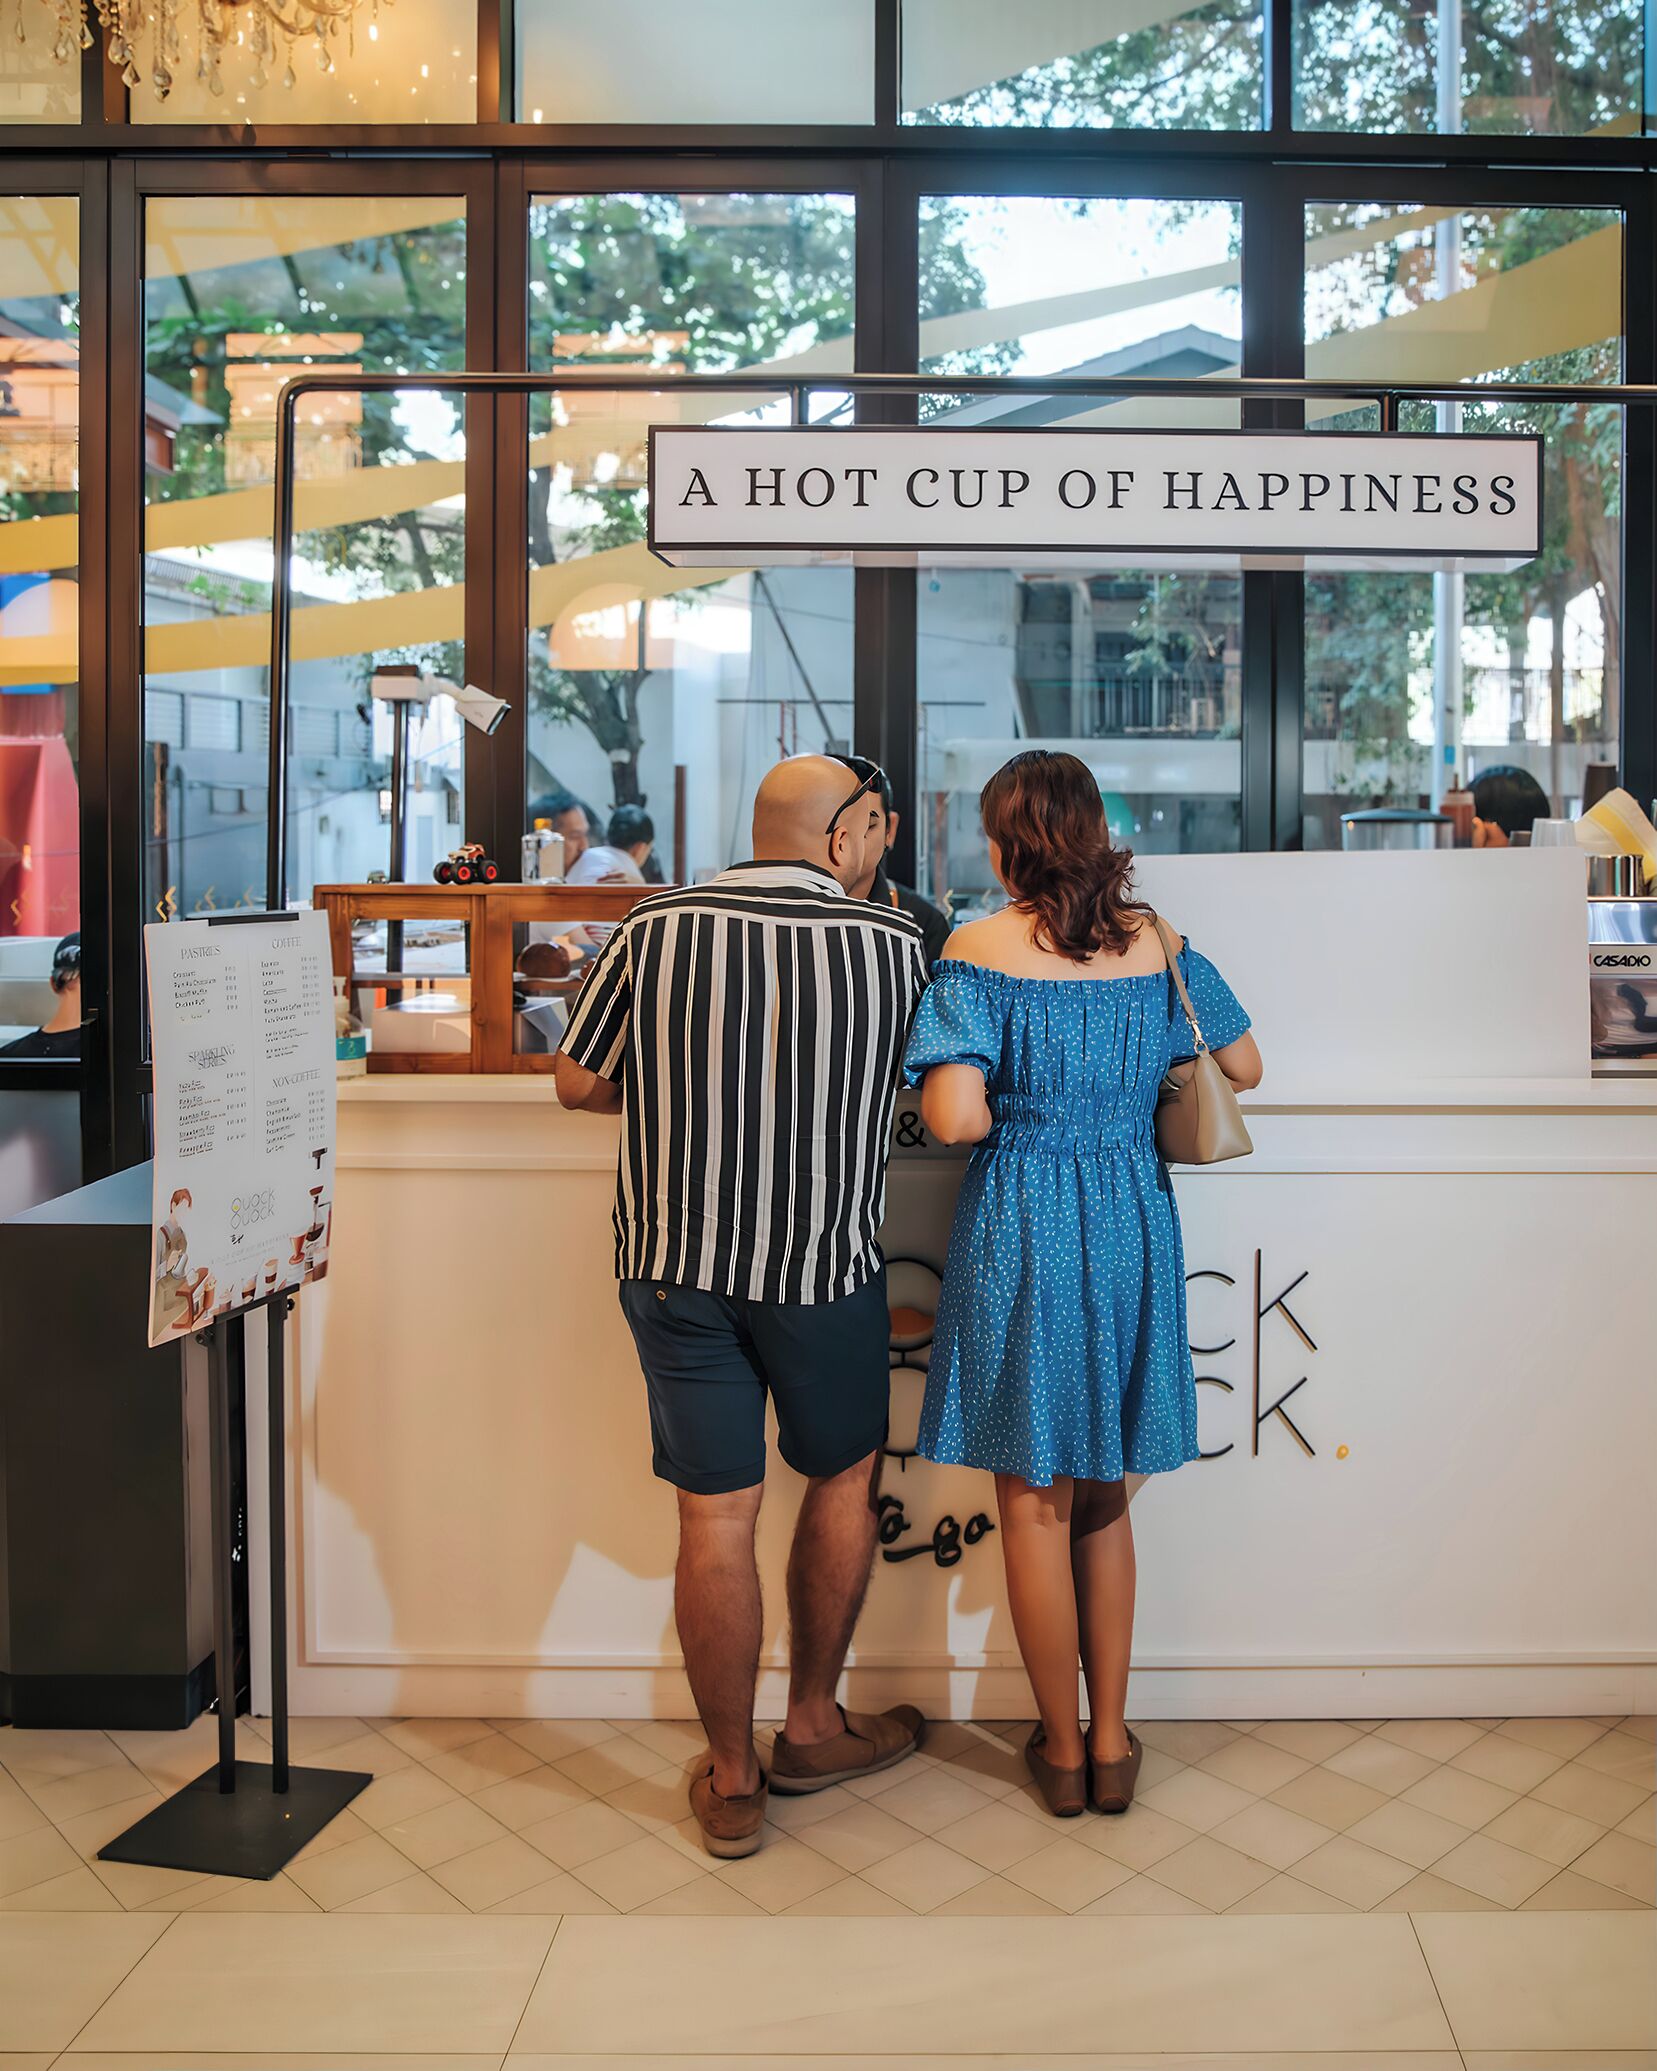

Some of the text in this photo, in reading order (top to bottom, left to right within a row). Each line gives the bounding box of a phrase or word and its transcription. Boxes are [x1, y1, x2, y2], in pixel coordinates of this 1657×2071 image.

[678, 467, 1516, 515] A HOT CUP OF HAPPINESS
[1593, 954, 1652, 967] CASADIO
[896, 1110, 928, 1148] &
[883, 1513, 995, 1568] go
